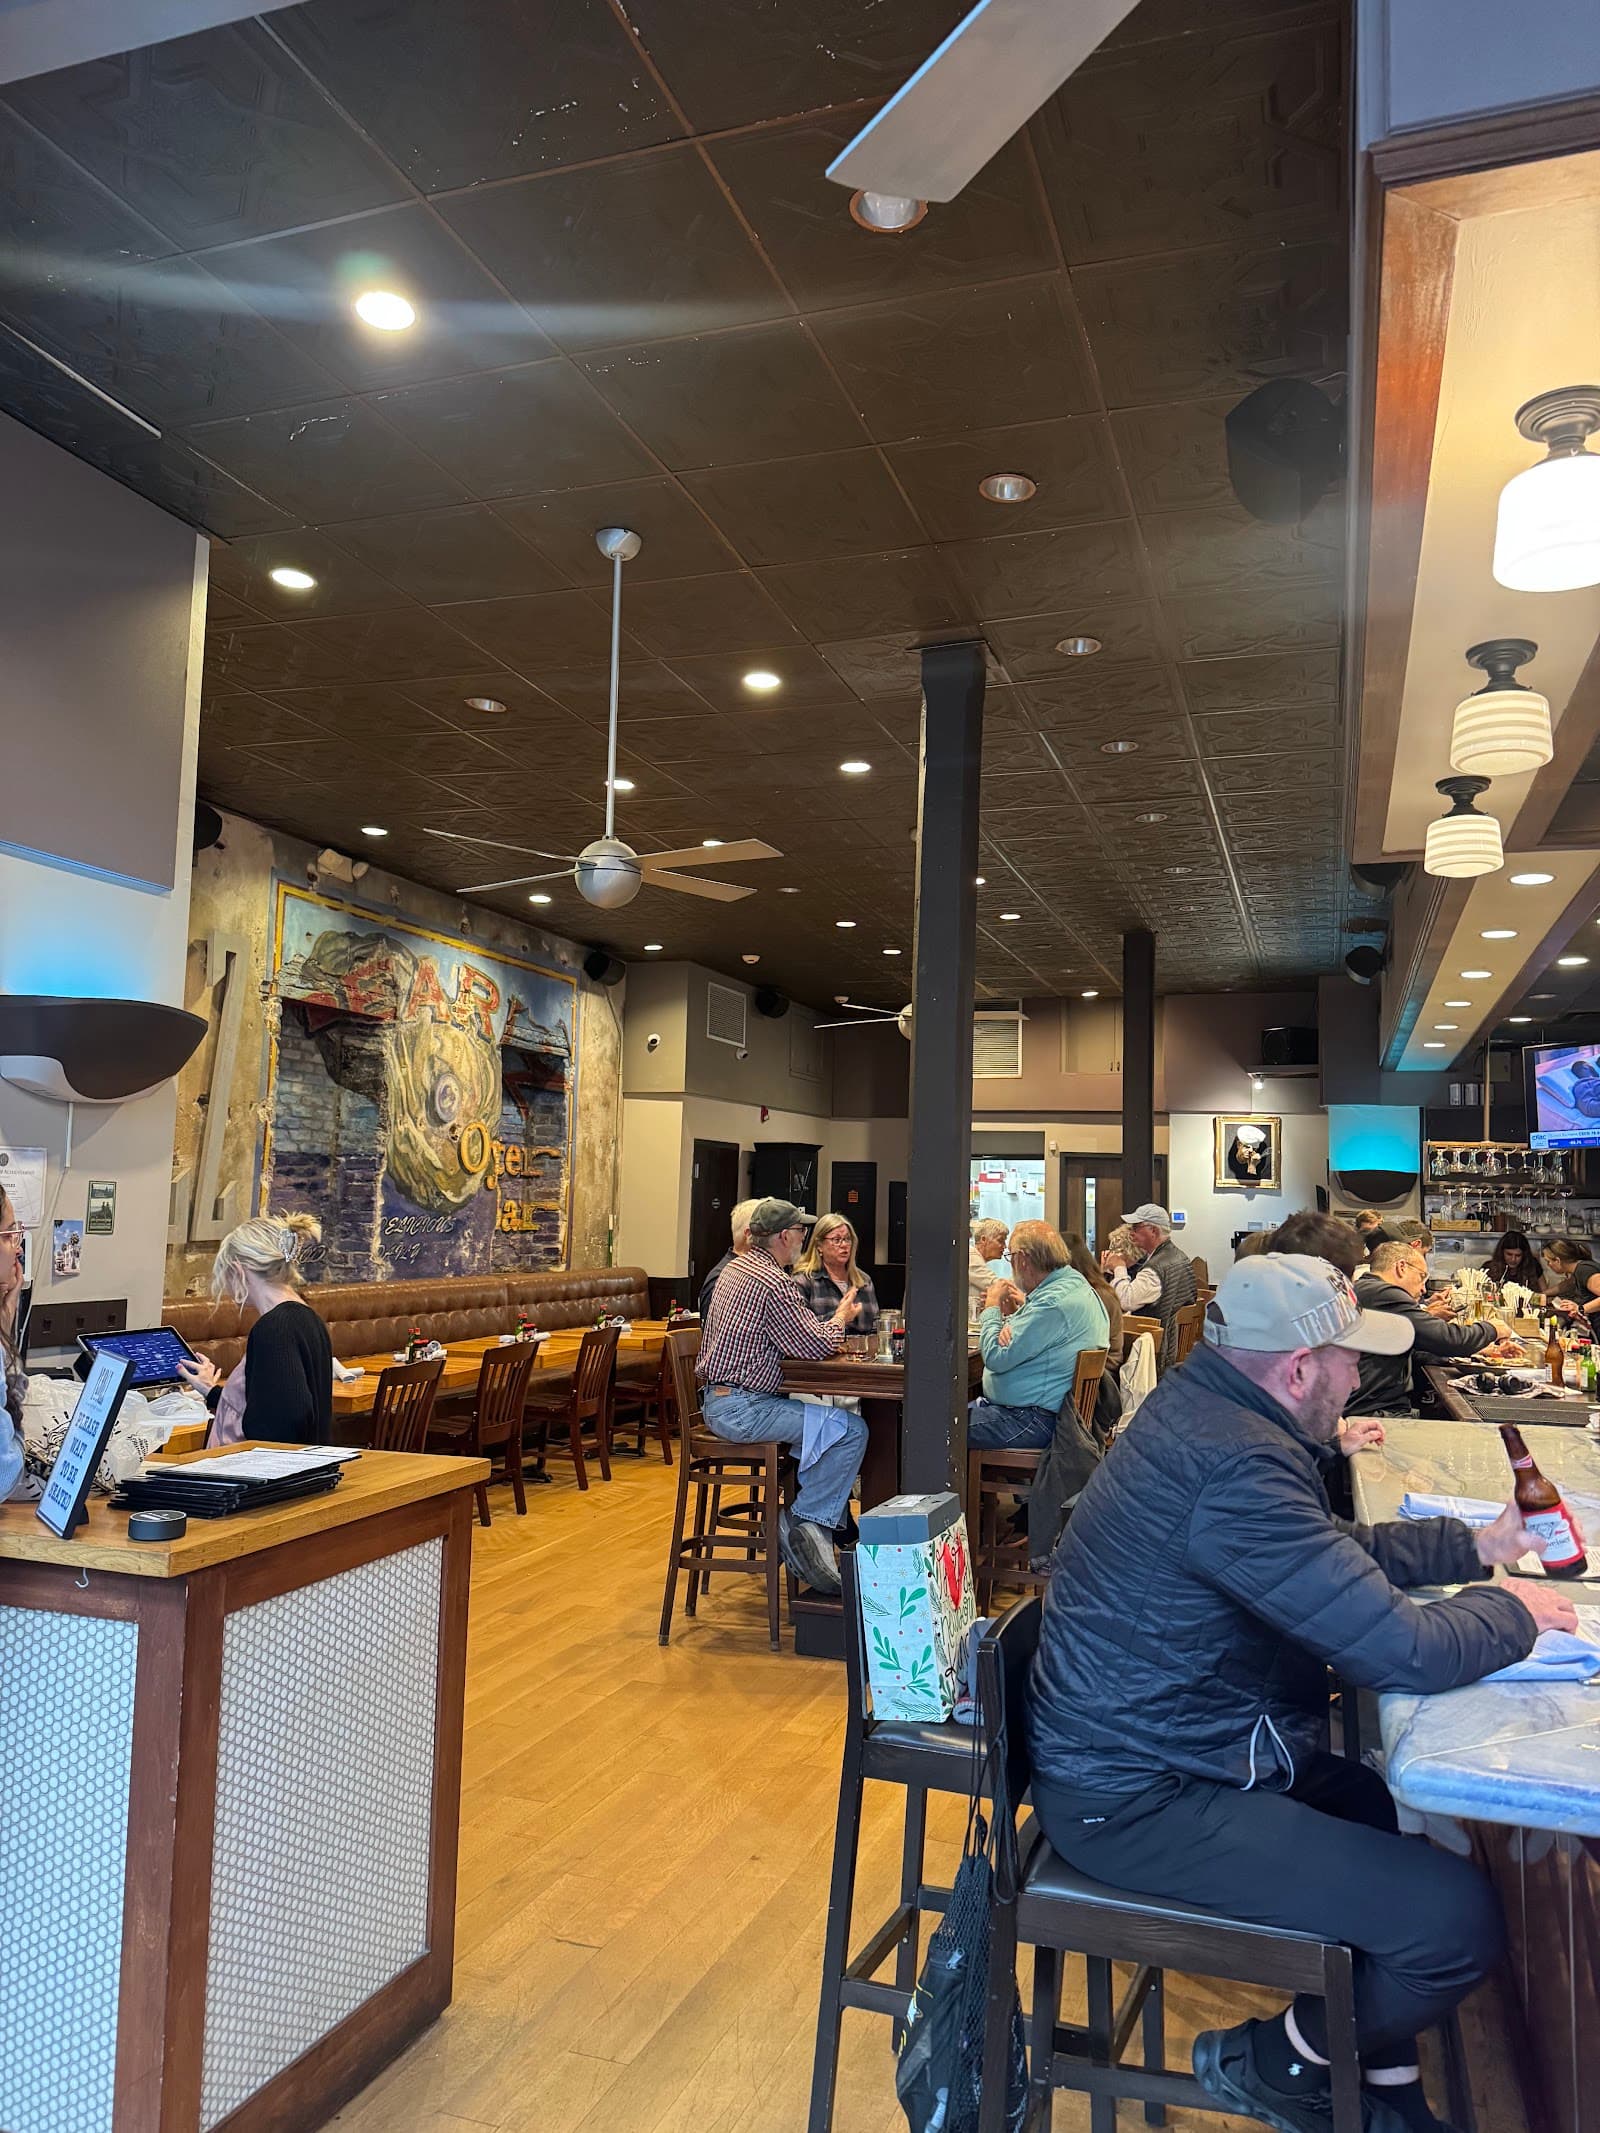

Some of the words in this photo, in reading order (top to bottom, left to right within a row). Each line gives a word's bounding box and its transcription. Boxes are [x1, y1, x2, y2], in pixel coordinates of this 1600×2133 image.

[74, 1411, 101, 1438] PLEASE
[70, 1436, 88, 1460] WAIT
[59, 1460, 71, 1480] TO
[66, 1465, 80, 1485] BE
[47, 1481, 73, 1511] SEATED
